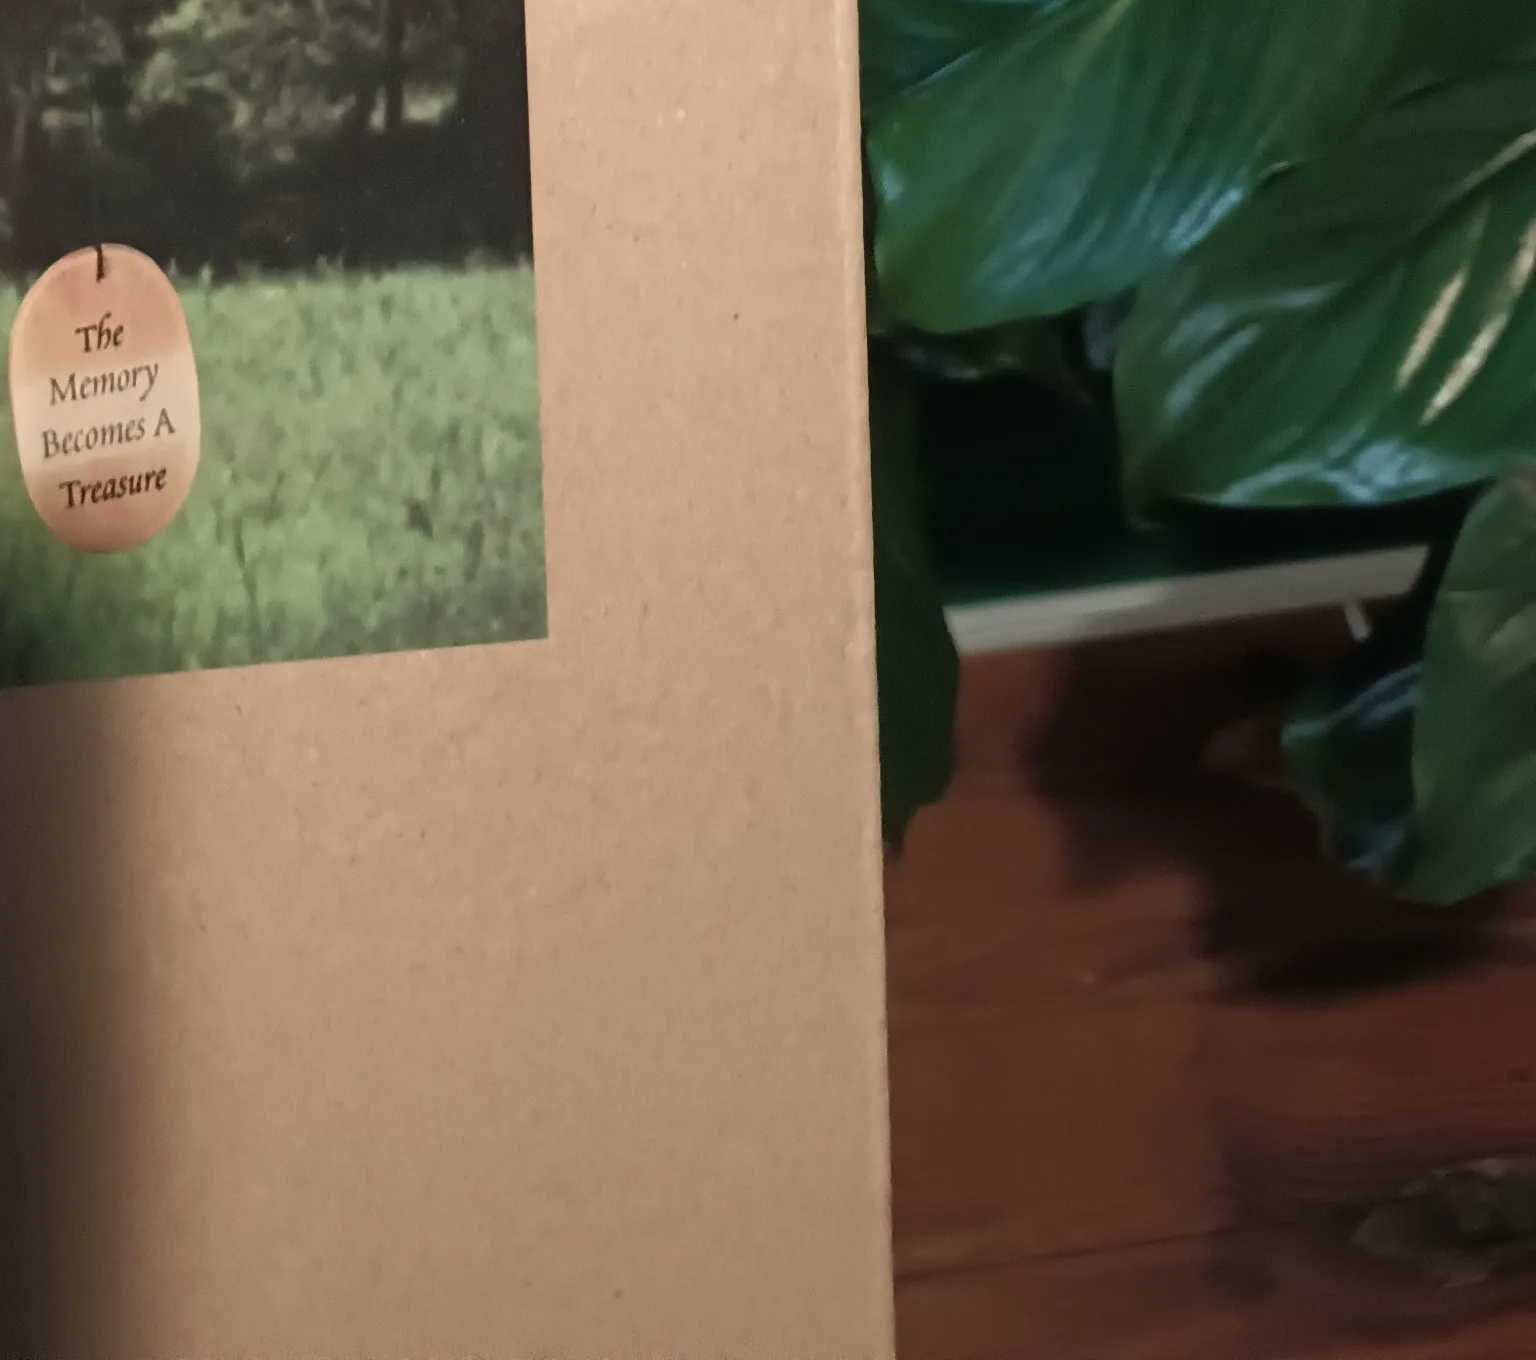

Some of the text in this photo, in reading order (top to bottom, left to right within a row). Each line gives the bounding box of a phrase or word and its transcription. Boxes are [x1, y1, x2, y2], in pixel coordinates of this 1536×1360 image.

[75, 311, 124, 353] The
[49, 362, 160, 406] Memory
[42, 407, 176, 459] Becomes A
[59, 467, 167, 509] Treasure
